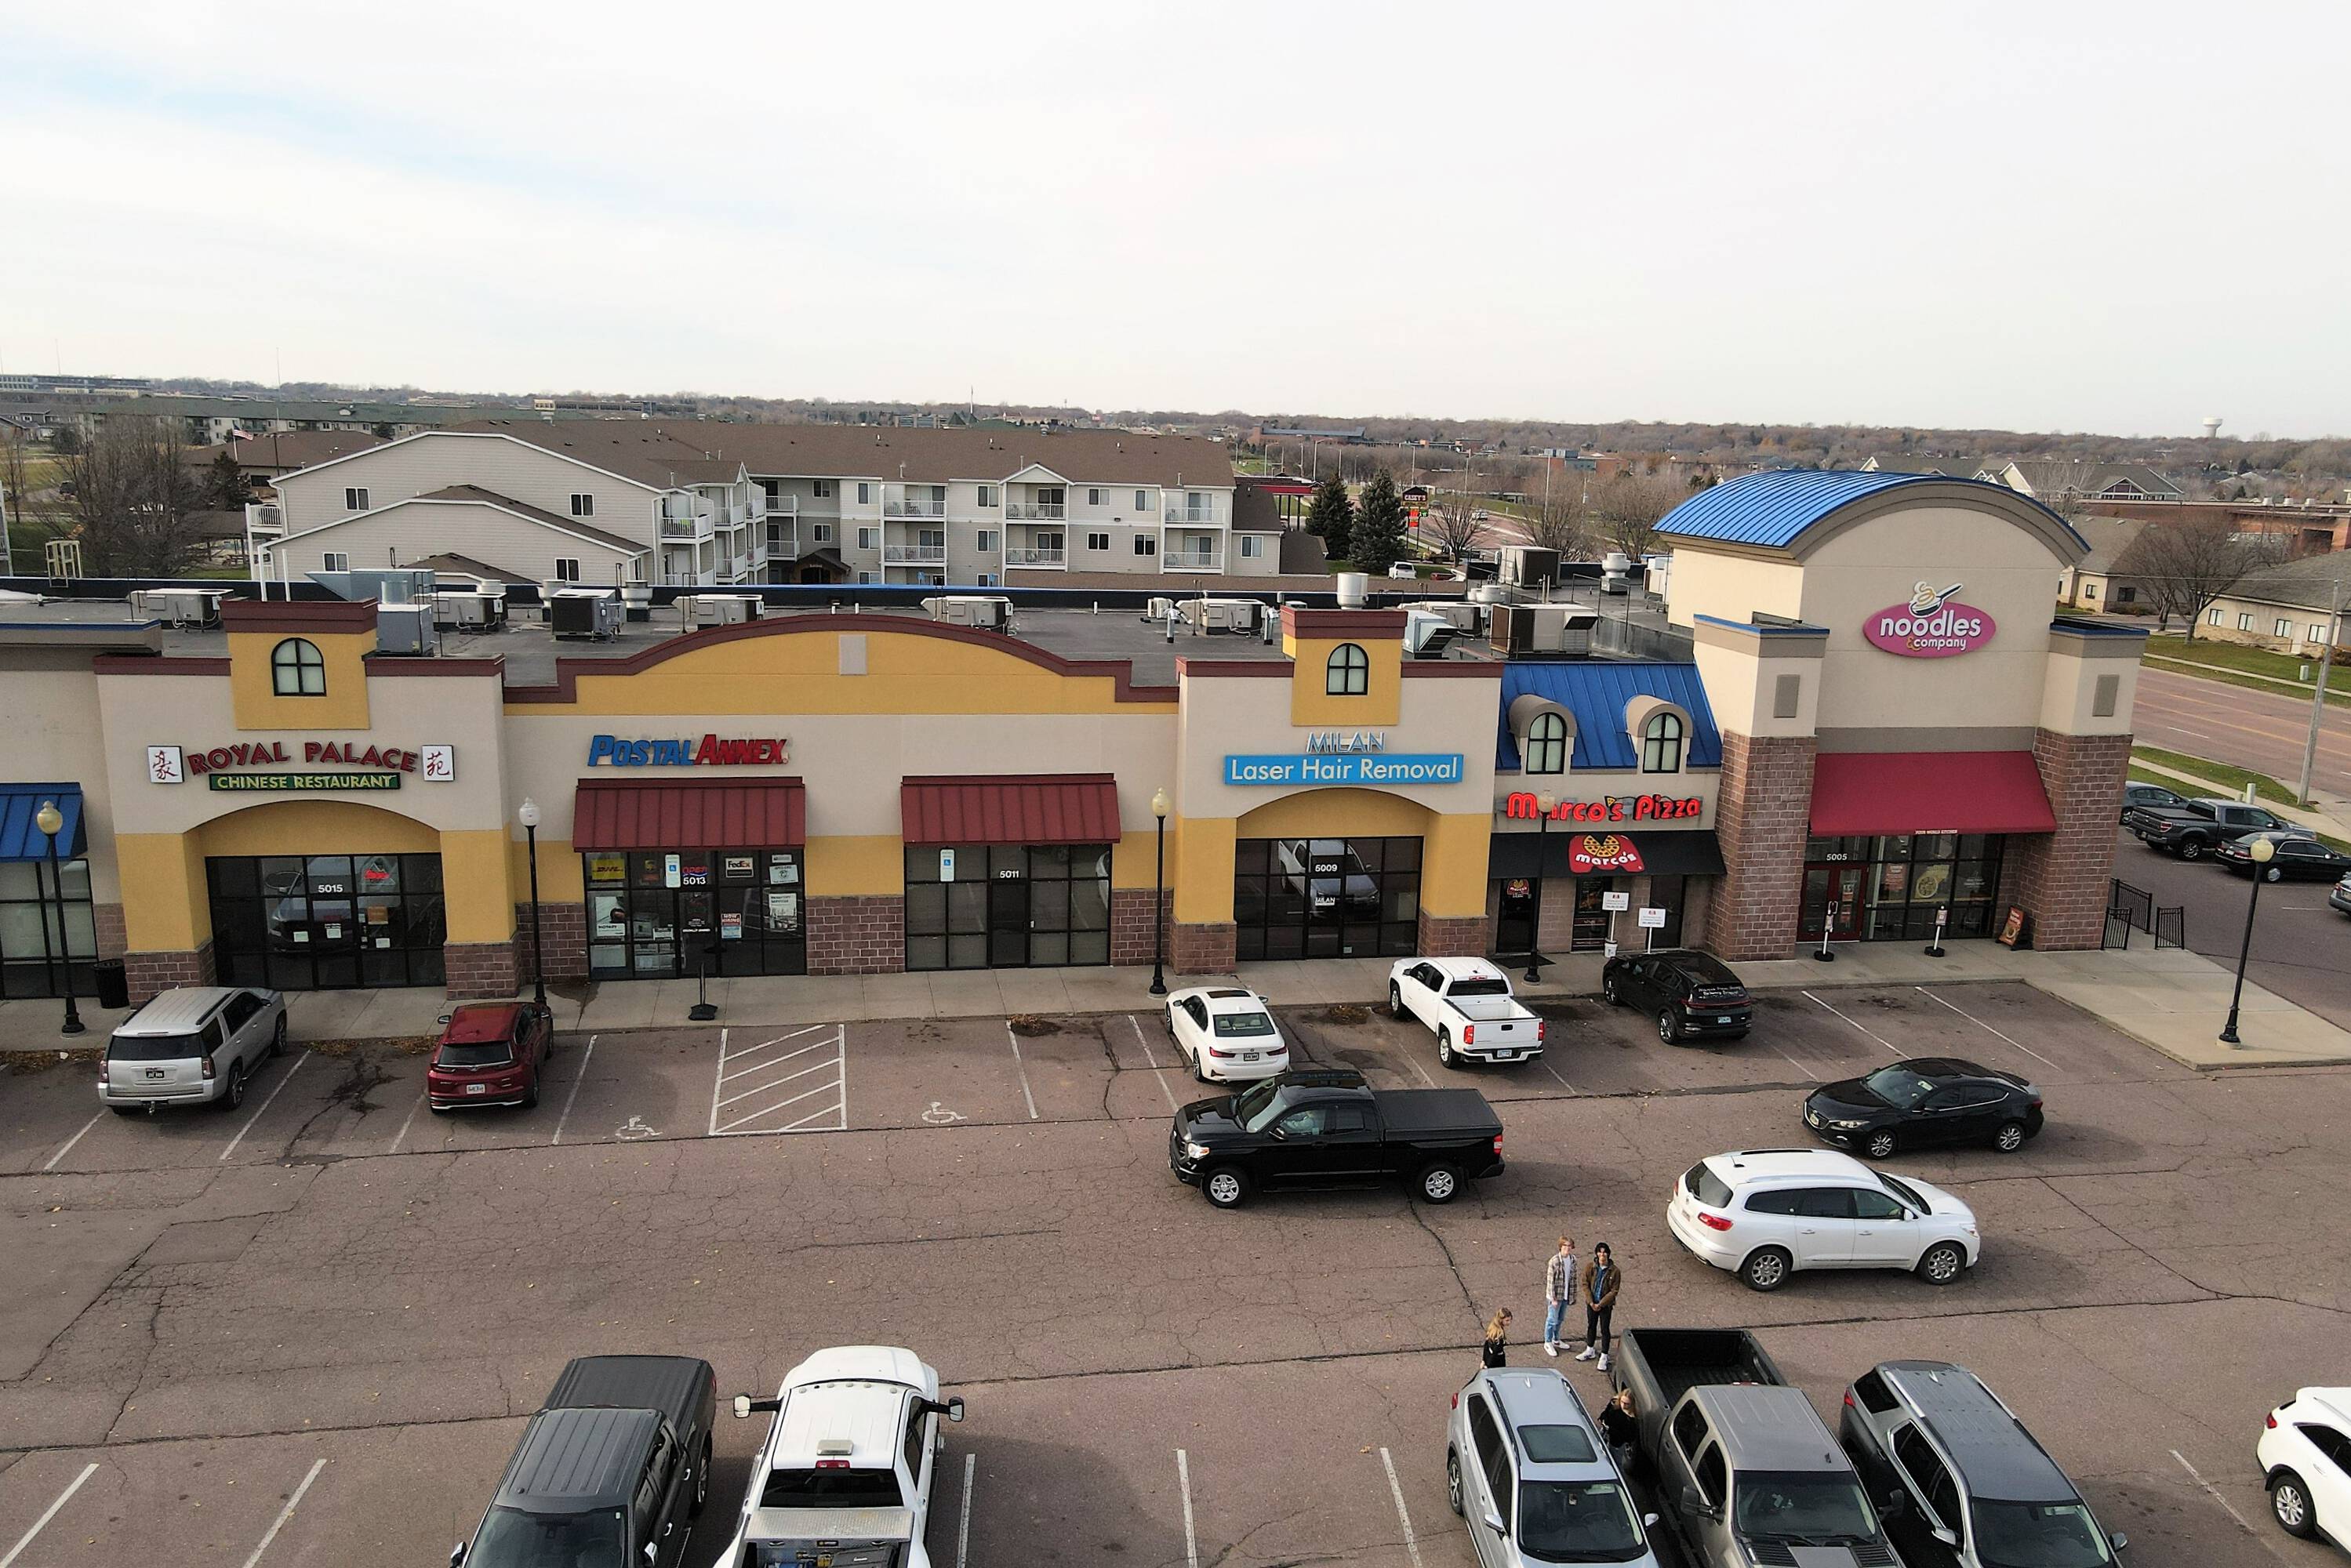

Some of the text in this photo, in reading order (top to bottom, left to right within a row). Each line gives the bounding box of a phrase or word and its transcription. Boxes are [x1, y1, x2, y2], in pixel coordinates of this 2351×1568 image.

[1880, 610, 1982, 637] noodles
[1305, 731, 1386, 753] MILAN
[187, 741, 419, 775] ROYAL PALACE
[1231, 757, 1458, 781] Laser Hair Removal
[216, 775, 397, 789] CHINESE RESTAURANT
[1633, 793, 1701, 821] Pizza
[1575, 851, 1637, 866] marco's
[683, 877, 707, 885] 5013
[999, 869, 1019, 878] 5011
[318, 884, 343, 893] 5015
